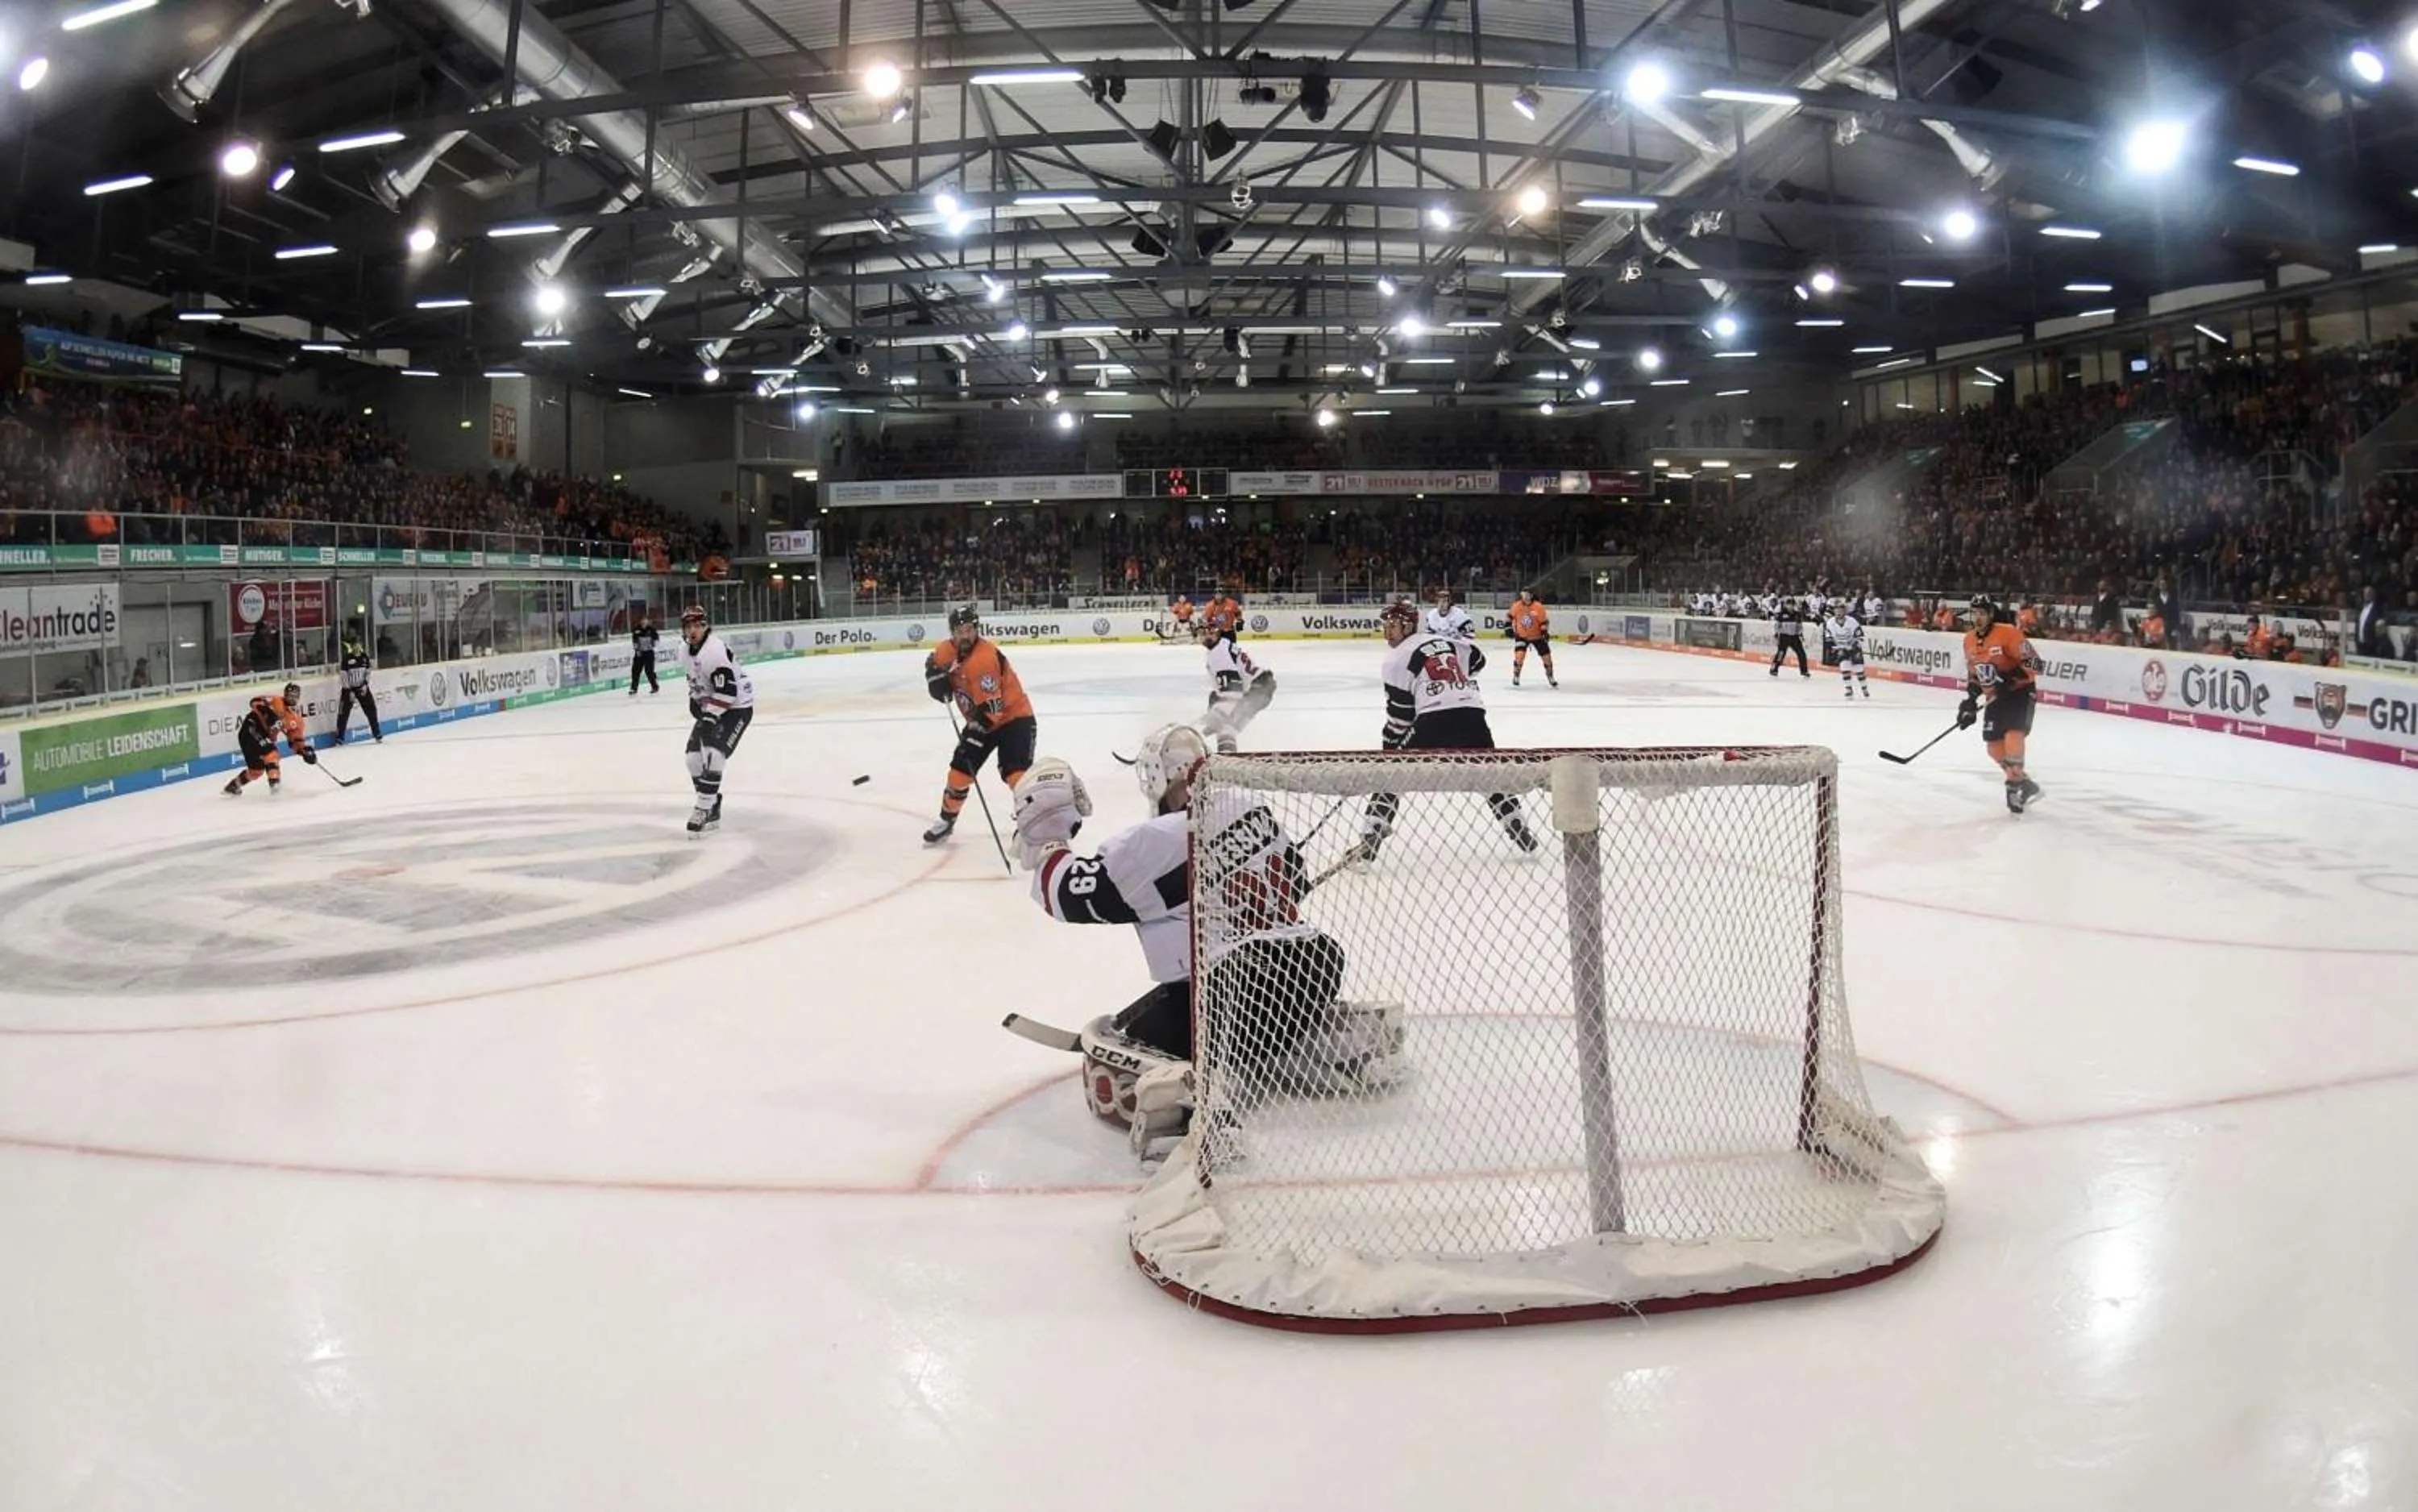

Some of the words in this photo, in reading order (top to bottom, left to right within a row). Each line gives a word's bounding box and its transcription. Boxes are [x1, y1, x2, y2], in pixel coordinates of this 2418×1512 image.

[0, 604, 115, 642] leantrade
[815, 631, 837, 645] Der
[841, 629, 877, 642] Polo.
[978, 622, 1060, 640] lkswagen
[1302, 616, 1382, 633] Volkswag
[1485, 617, 1504, 629] De
[1869, 638, 1951, 672] Volkswagen
[459, 668, 536, 696] Volkswagen
[2181, 663, 2270, 717] Gilde
[2370, 697, 2417, 735] GRI
[33, 740, 104, 771] AUTOMOBILE
[1069, 855, 1099, 895] 29
[1091, 1045, 1140, 1070] CCM
